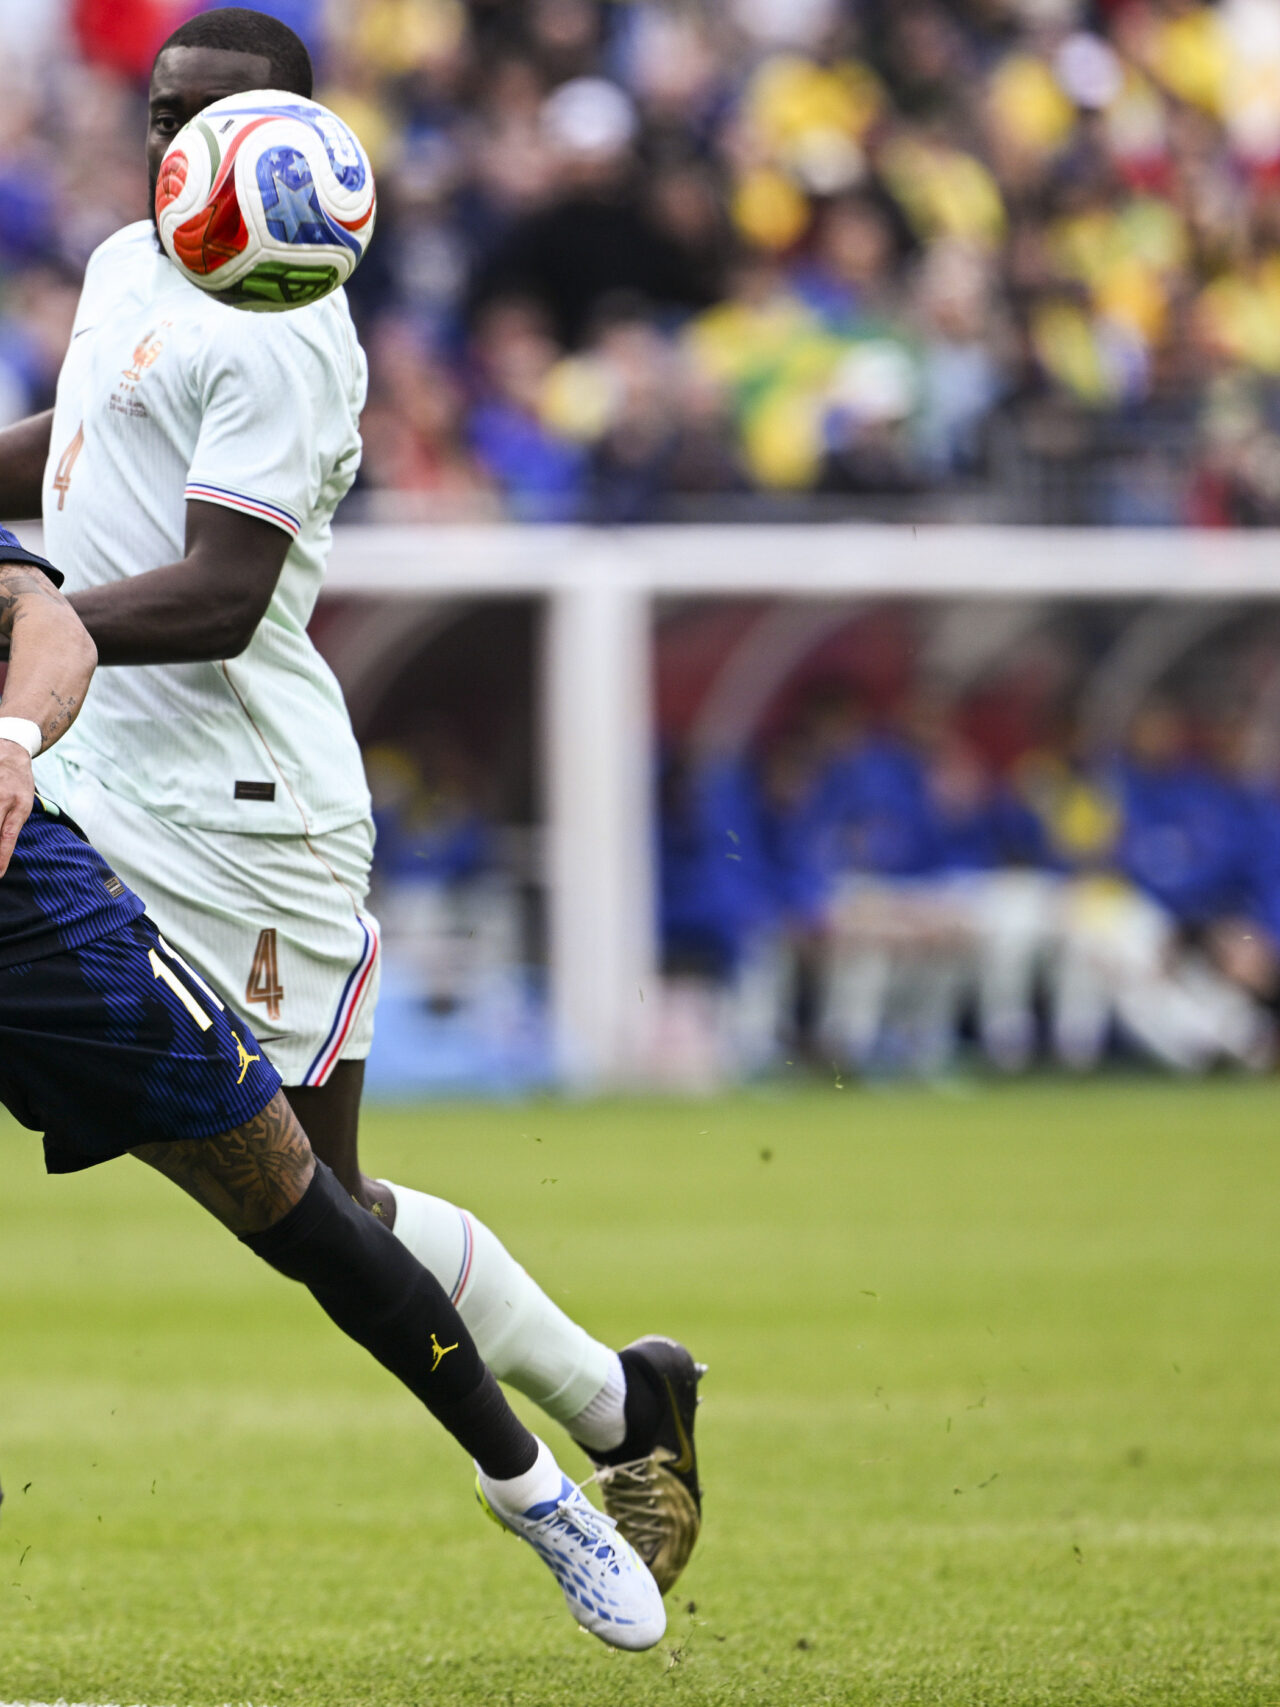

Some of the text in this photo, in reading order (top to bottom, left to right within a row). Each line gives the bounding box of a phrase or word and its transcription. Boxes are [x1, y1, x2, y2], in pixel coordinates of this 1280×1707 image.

[53, 420, 84, 512] 4
[148, 934, 225, 1032] 11
[245, 928, 284, 1021] 4
